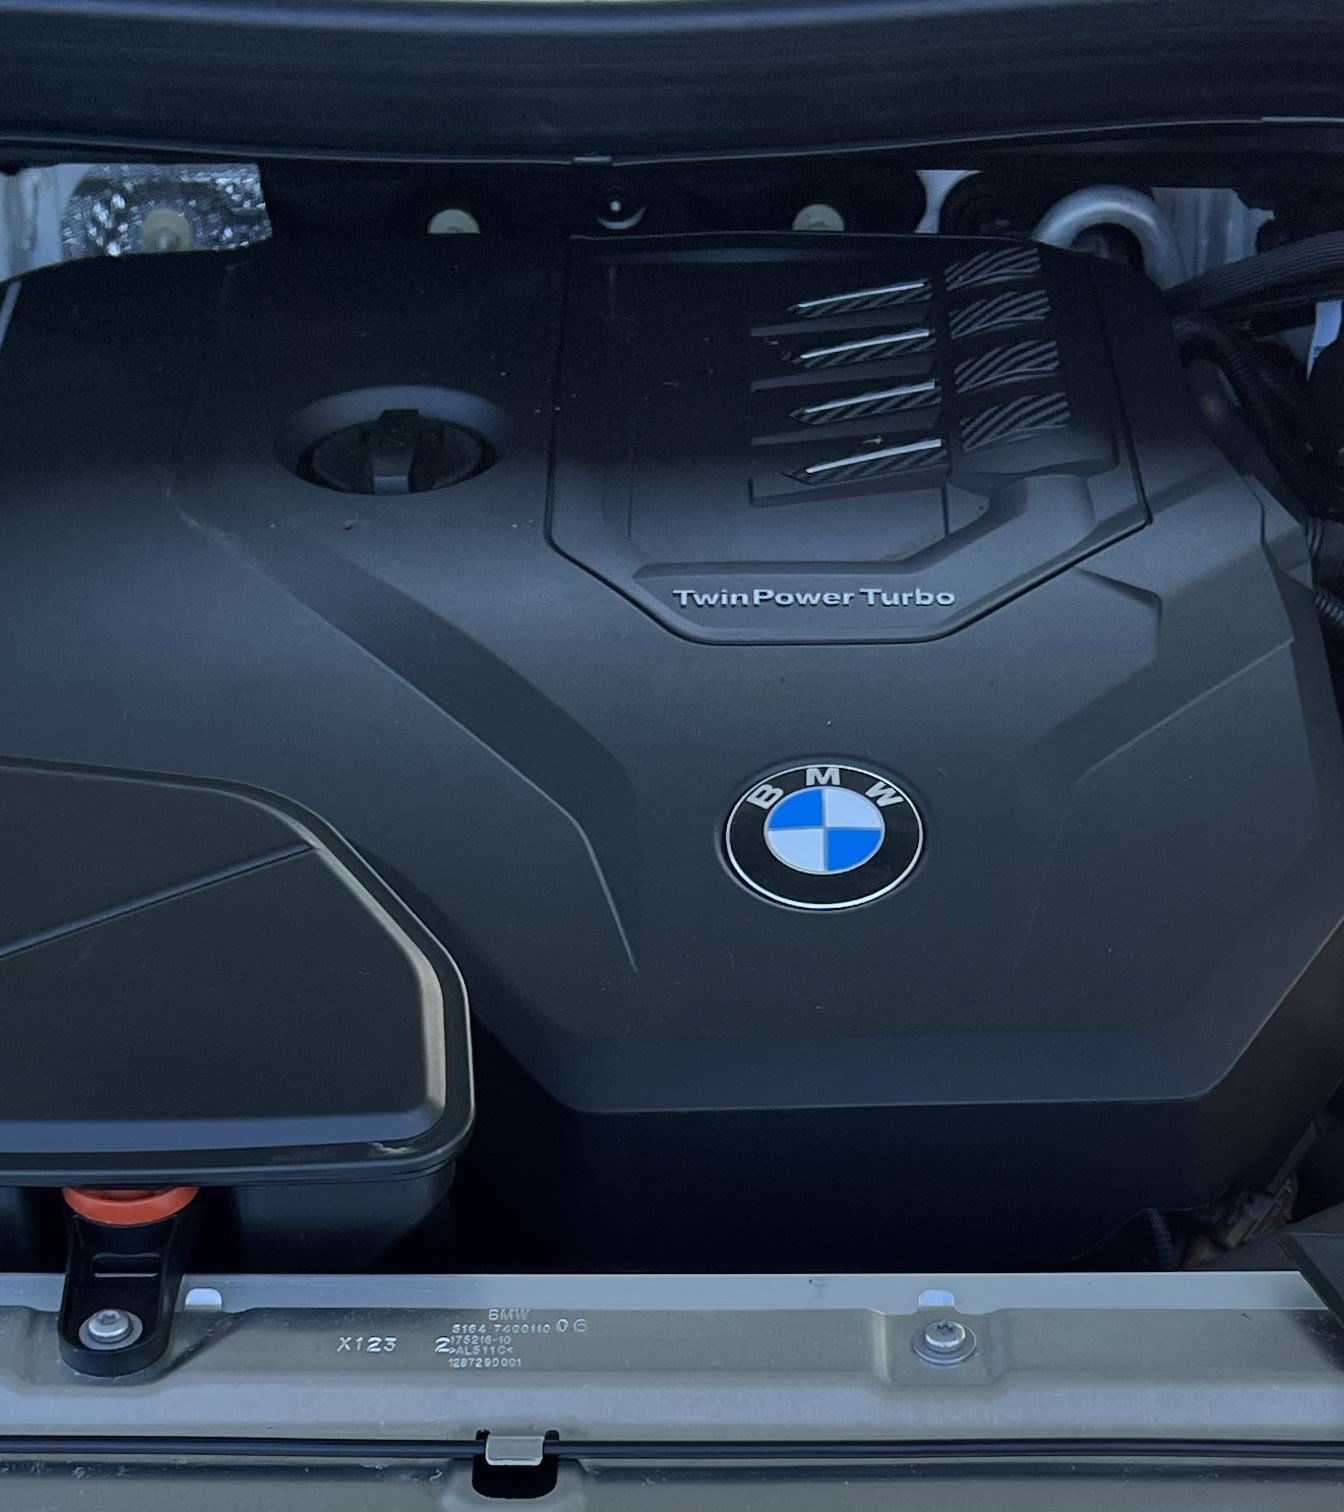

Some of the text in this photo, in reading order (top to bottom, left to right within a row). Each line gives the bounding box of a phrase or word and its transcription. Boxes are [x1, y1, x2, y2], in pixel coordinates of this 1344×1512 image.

[858, 587, 956, 607] Turbo
[745, 767, 905, 810] BMW
[488, 1308, 531, 1320] BMW
[452, 1323, 487, 1334] 5164
[337, 1336, 397, 1353] X123
